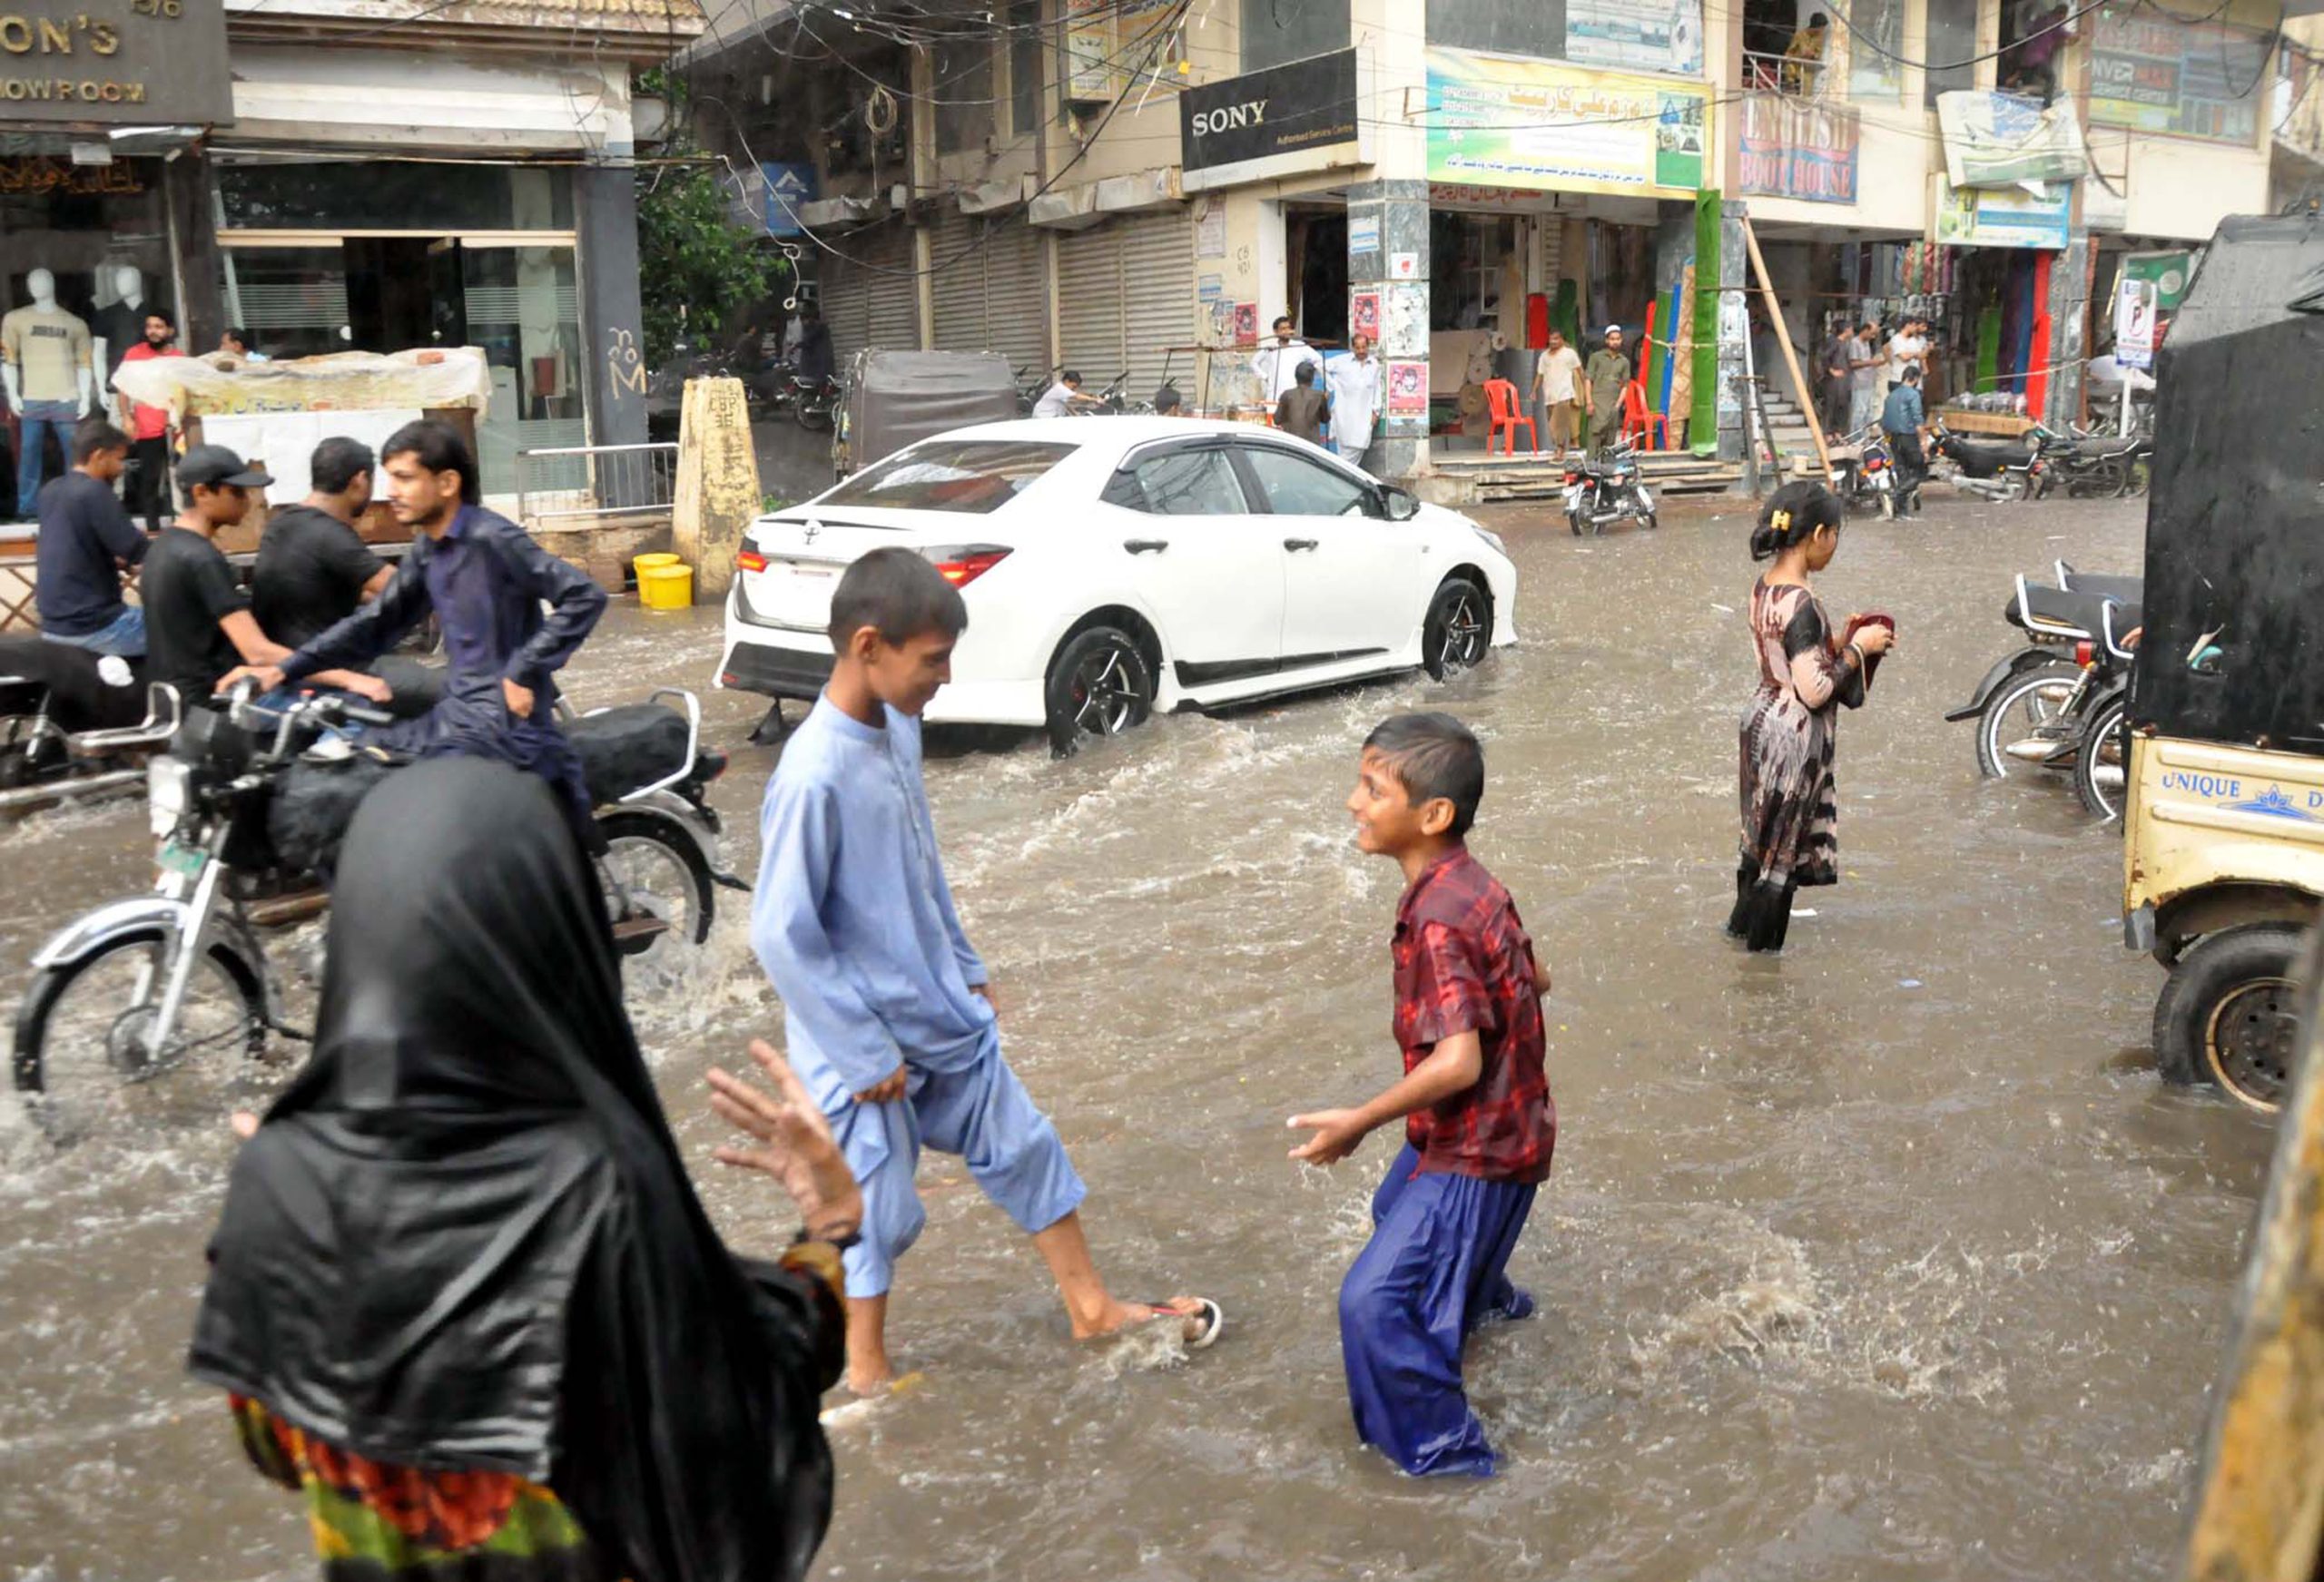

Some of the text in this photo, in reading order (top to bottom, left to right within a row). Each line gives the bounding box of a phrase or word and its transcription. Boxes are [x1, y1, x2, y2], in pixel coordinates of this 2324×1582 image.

[0, 78, 145, 103] OWROOM
[1192, 99, 1268, 137] SONY
[1794, 158, 1851, 199] HOUSE
[2162, 771, 2240, 798] UNIQUE
